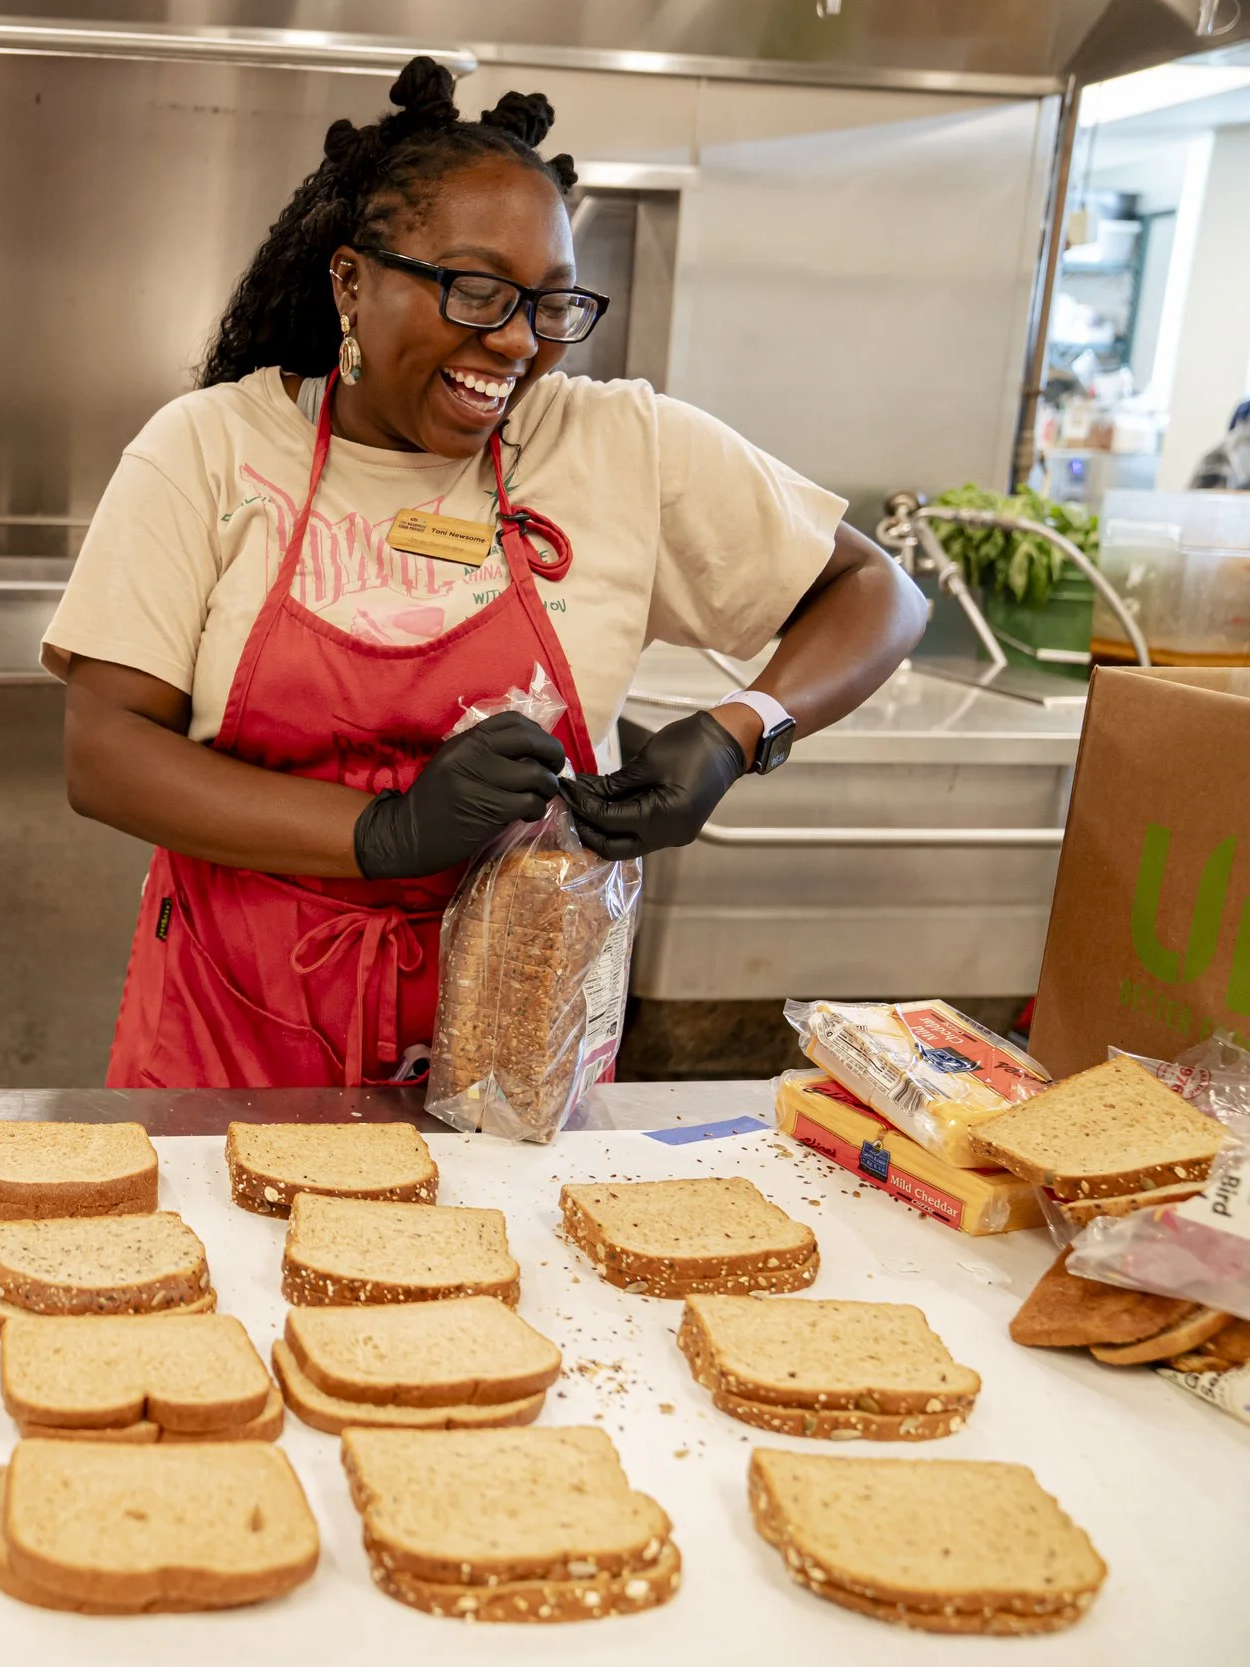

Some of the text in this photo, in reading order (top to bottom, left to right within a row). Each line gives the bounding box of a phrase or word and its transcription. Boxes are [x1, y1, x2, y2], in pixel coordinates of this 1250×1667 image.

[431, 527, 486, 544] Toni Newsome
[910, 1026, 940, 1041] Mild
[919, 1016, 965, 1044] Cheddar
[890, 1175, 959, 1217] Mild Cheddar
[1212, 1174, 1242, 1218] Bird
